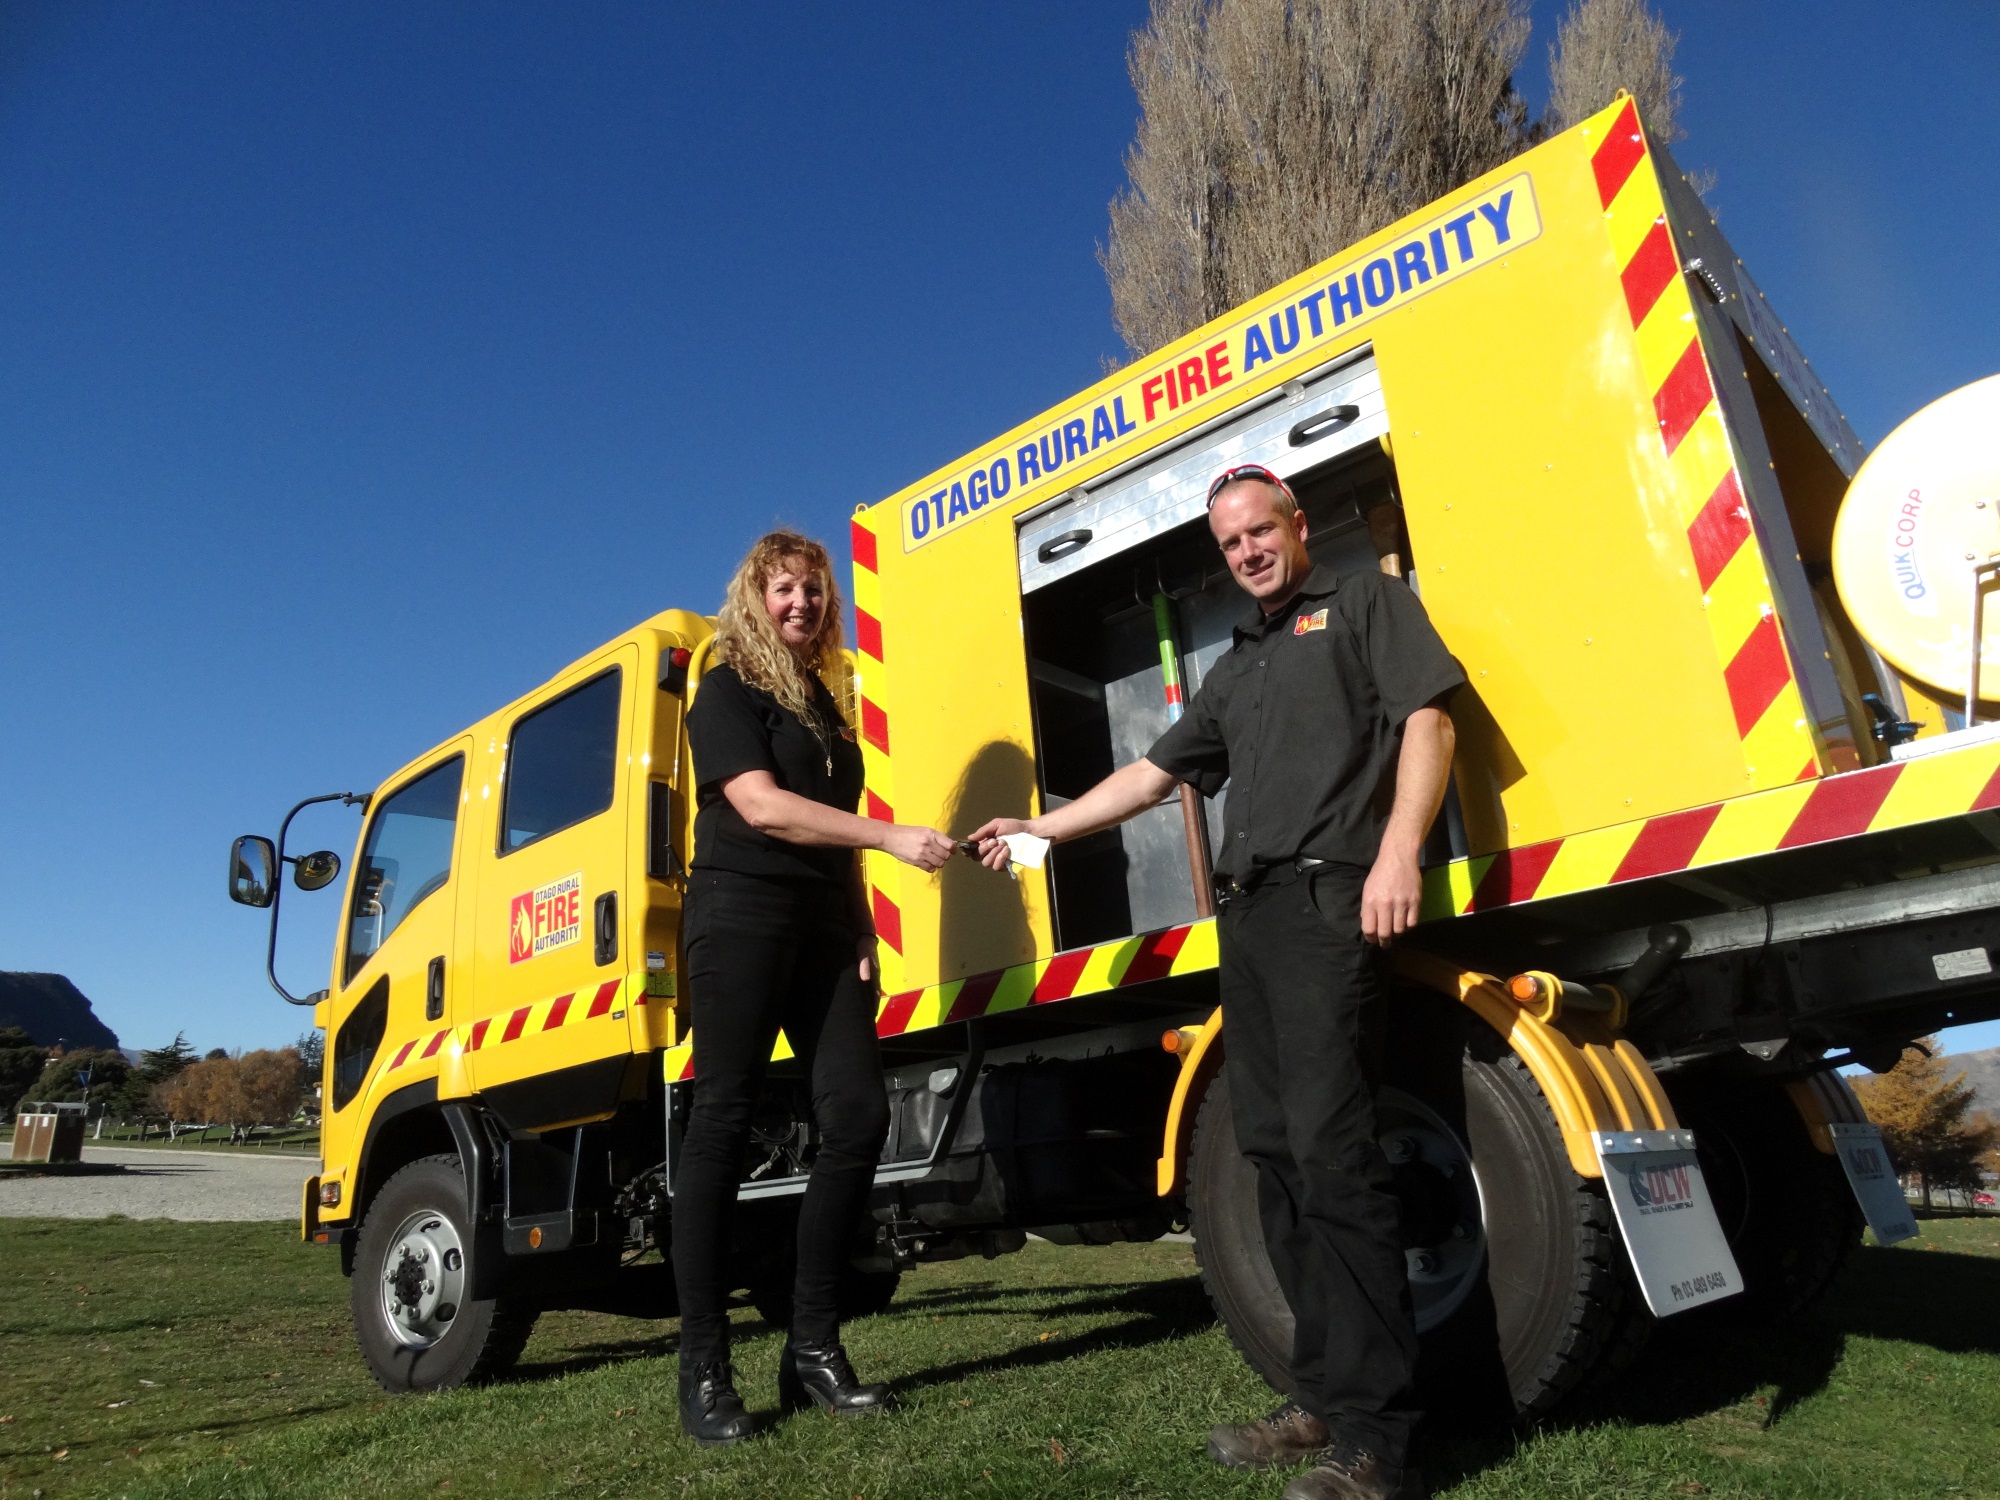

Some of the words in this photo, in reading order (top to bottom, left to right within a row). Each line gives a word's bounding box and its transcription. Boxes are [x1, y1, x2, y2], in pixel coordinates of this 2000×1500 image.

[910, 457, 1012, 541] OTAGO
[1017, 394, 1137, 487] RURAL
[1139, 340, 1233, 423] FIRE
[1242, 190, 1514, 374] AUTHORITY
[1895, 488, 1923, 548] CORP
[1893, 551, 1926, 600] QUIK
[534, 888, 580, 939] FIRE
[535, 887, 556, 904] OTAGO
[557, 876, 580, 895] RURAL
[534, 924, 579, 953] AUTHORITY
[1670, 1283, 1685, 1302] Ph
